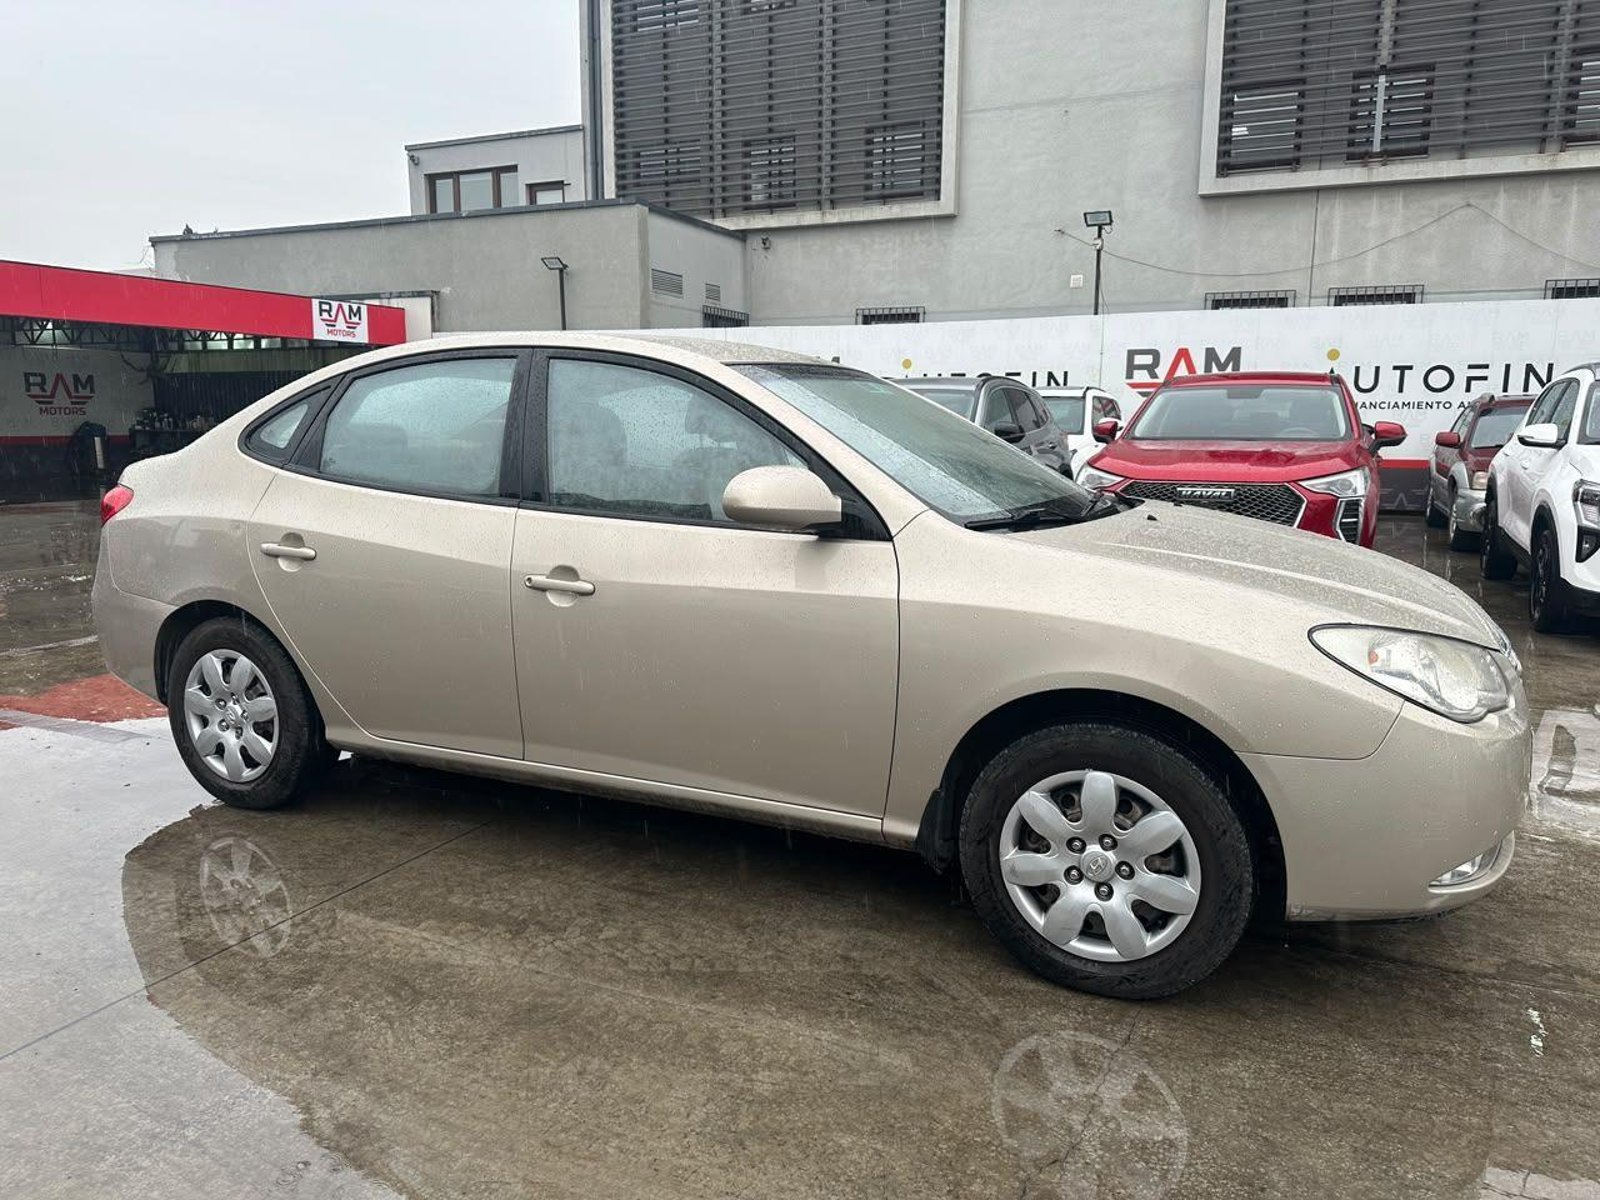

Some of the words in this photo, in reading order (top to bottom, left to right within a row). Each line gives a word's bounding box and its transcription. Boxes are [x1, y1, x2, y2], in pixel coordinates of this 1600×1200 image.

[318, 300, 362, 322] RAM
[327, 329, 357, 338] MOTORS
[1125, 347, 1242, 379] RAM
[23, 372, 96, 398] RAM
[1329, 362, 1554, 394] UTOFIN
[39, 406, 87, 416] MOTORS
